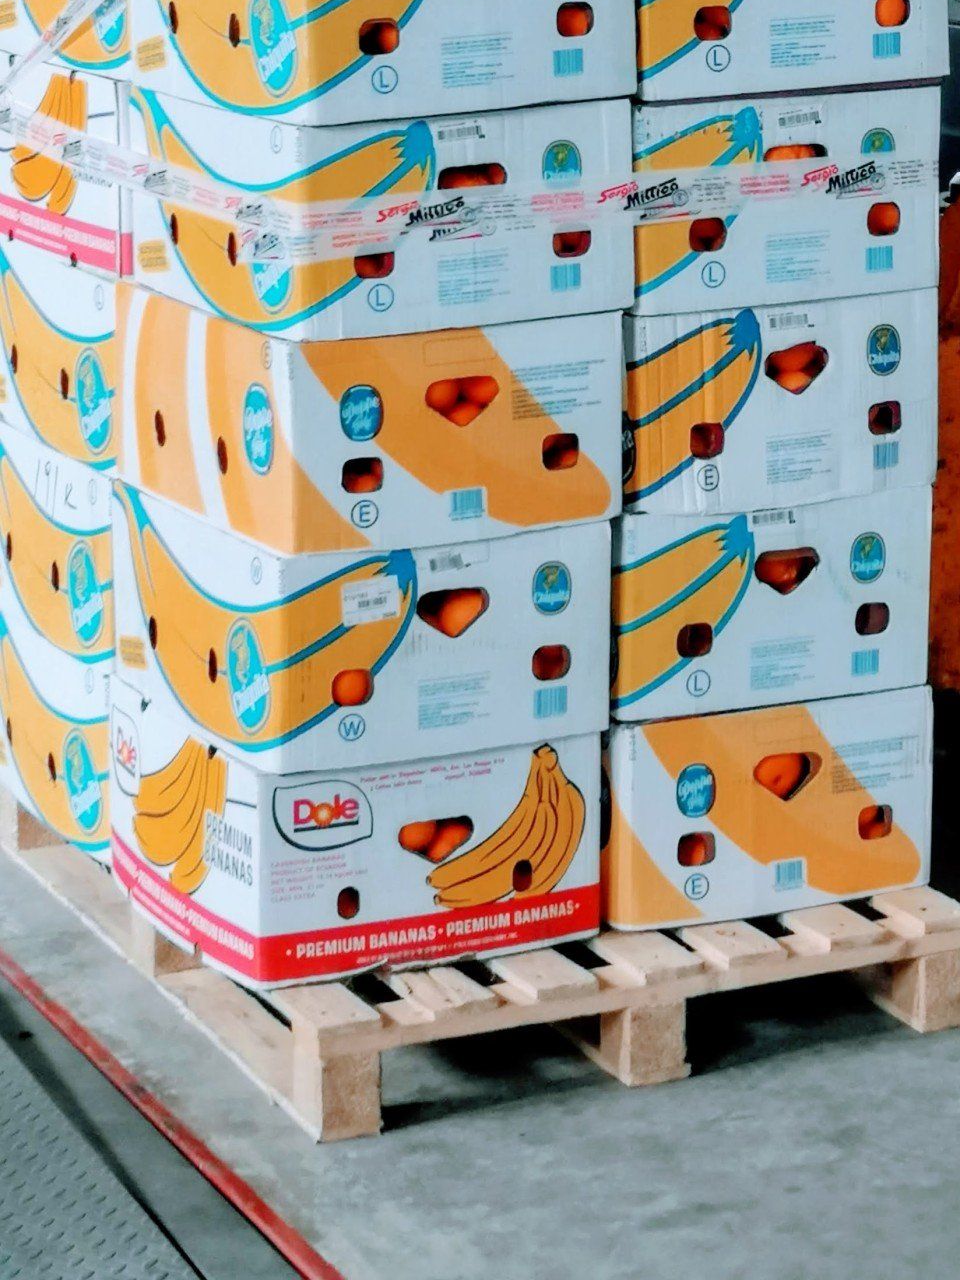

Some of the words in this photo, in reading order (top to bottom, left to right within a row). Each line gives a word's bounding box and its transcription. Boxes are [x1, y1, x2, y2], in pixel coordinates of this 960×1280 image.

[293, 793, 360, 827] Dole
[206, 810, 253, 858] PREMIUM
[205, 842, 254, 887] BANANAS
[296, 934, 366, 959] PREMIUM
[369, 924, 437, 951] BANANAS
[446, 912, 510, 937] PREMIUM
[514, 903, 575, 927] BANANAS
